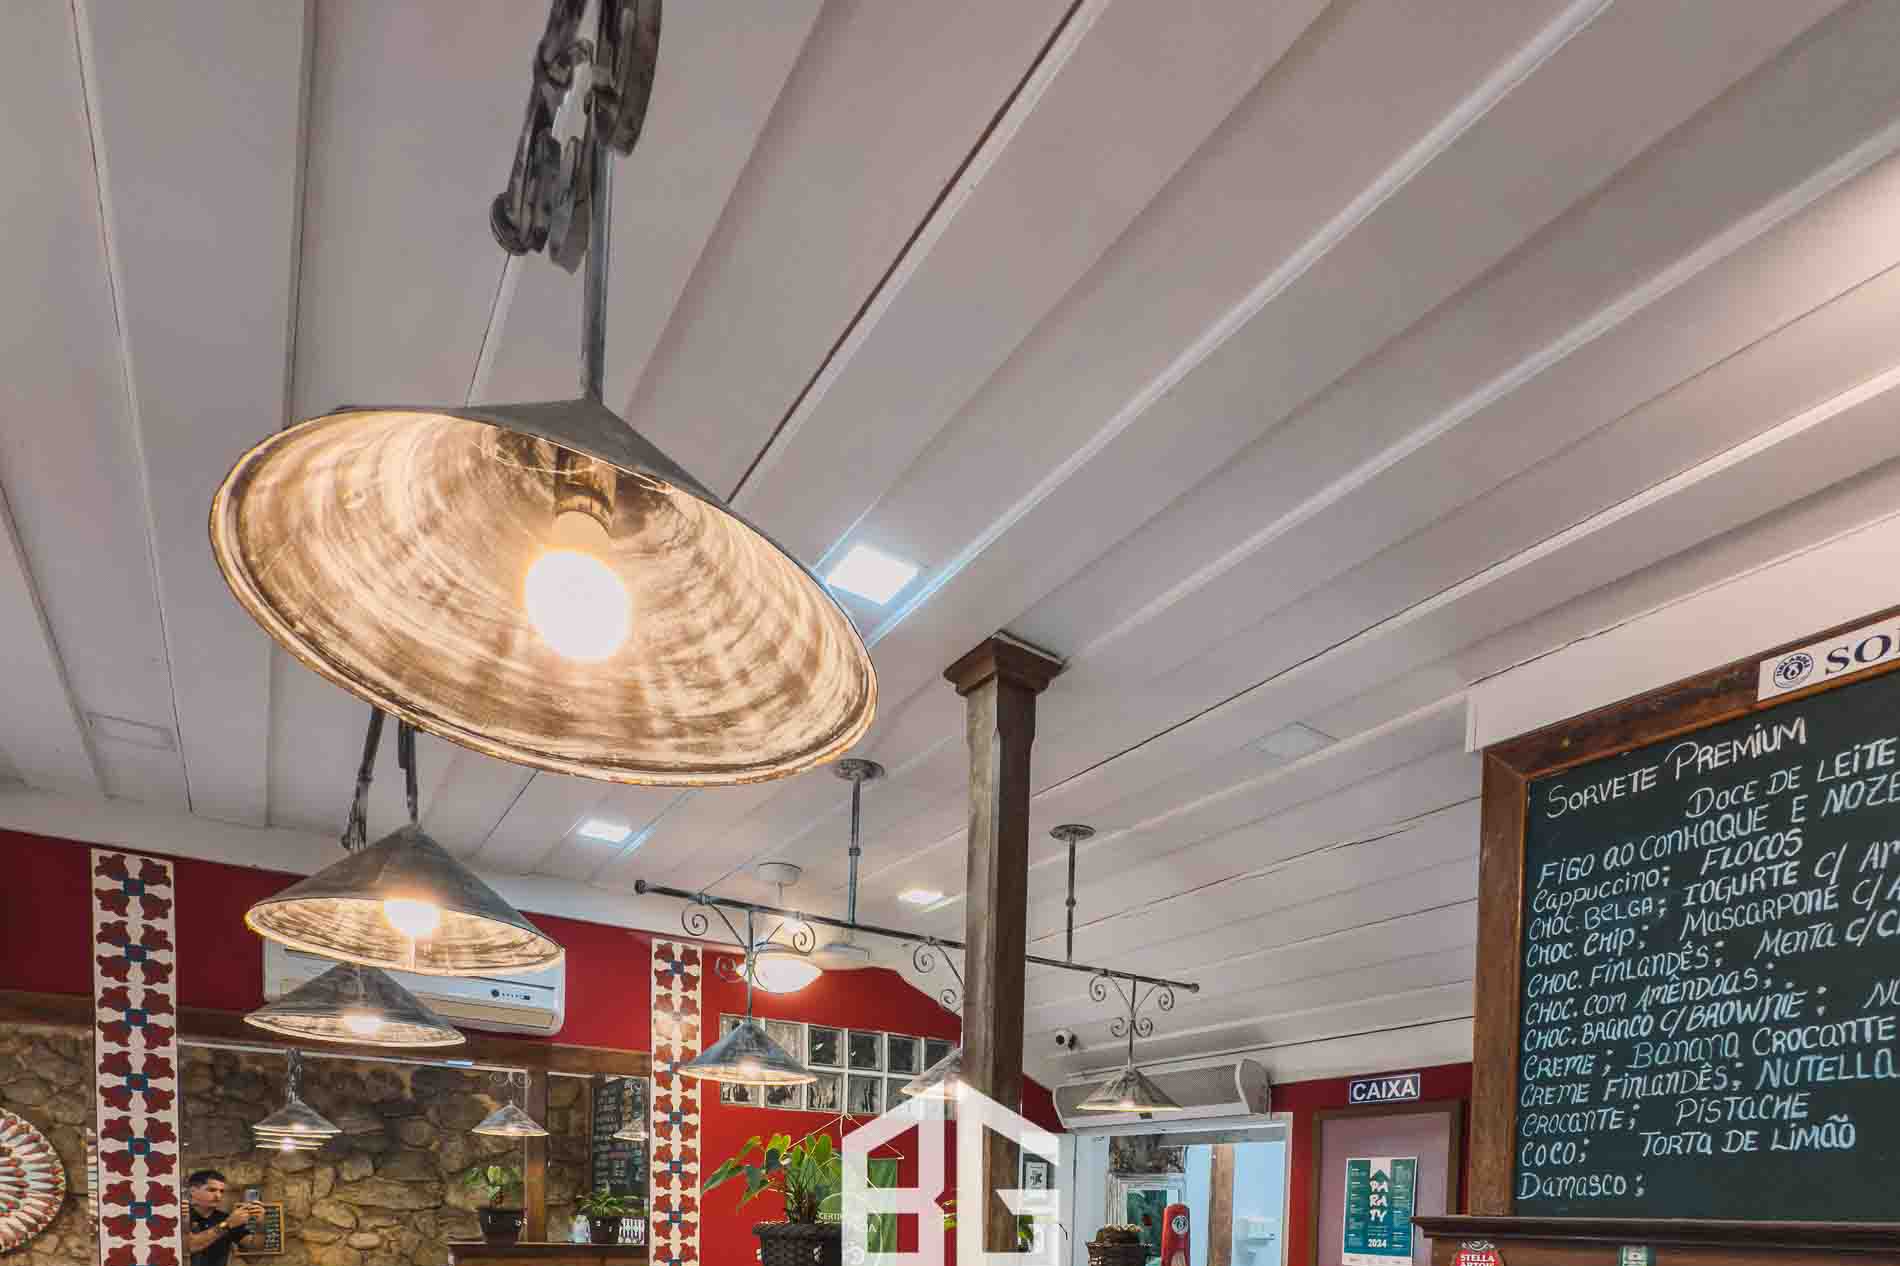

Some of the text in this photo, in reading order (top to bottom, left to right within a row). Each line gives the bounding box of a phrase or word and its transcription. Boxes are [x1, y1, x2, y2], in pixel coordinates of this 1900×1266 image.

[1547, 765, 1659, 818] SORVETE
[1685, 780, 1759, 818] DOCE
[1766, 766, 1803, 795] DE
[1791, 795, 1808, 823] E
[1700, 827, 1803, 876] FLOCOS
[1682, 860, 1800, 908] IOGURTE
[1352, 1078, 1417, 1101] CAIXA
[1521, 1083, 1591, 1107] CREME
[1721, 1130, 1760, 1153] DE
[1368, 1239, 1388, 1249] 2024
[1459, 1254, 1495, 1263] STELLA
